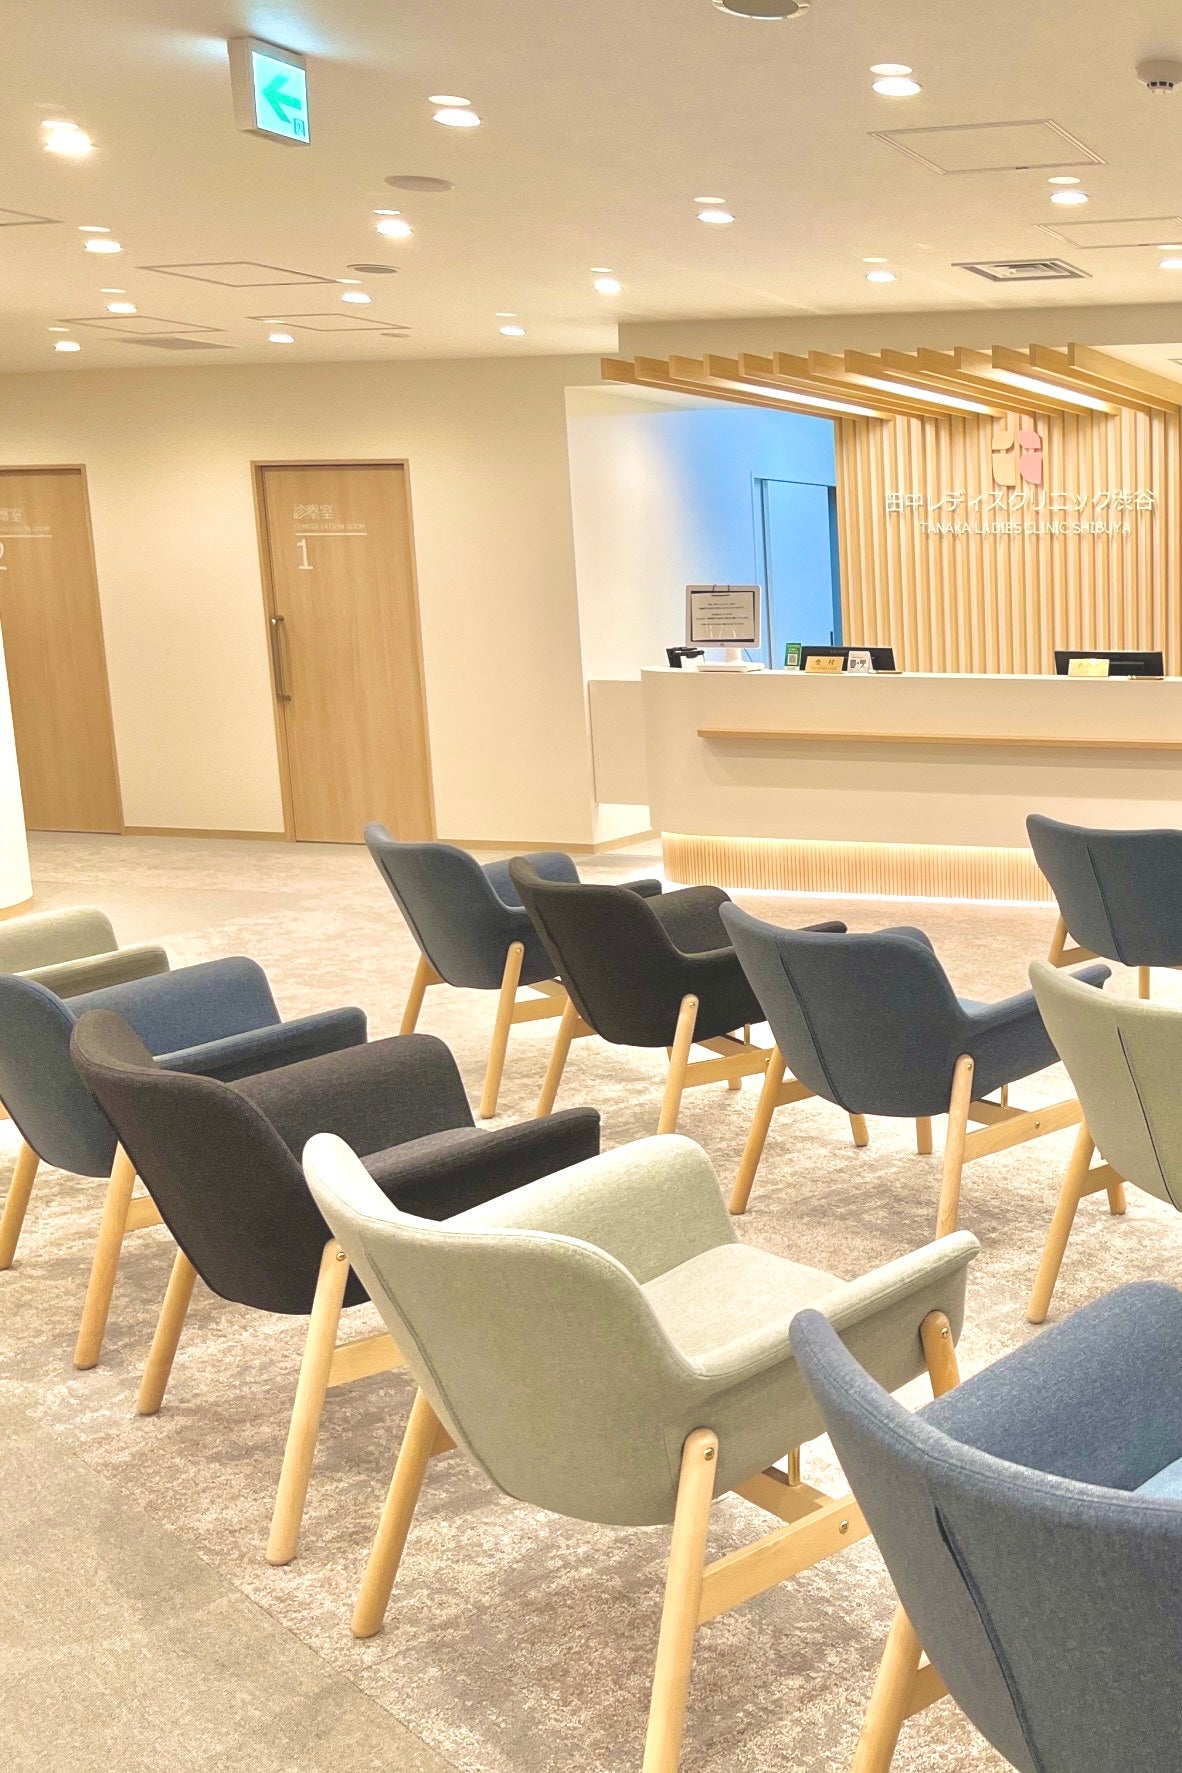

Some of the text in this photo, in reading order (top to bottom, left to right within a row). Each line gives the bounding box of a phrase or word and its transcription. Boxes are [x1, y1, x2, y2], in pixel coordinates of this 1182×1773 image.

[885, 488, 1155, 513] 田中レディスクリニック渋谷
[293, 504, 335, 520] 診察室
[920, 521, 1131, 534] TANAKA LADIES CLINIC SHIBUYA
[296, 538, 314, 570] 1
